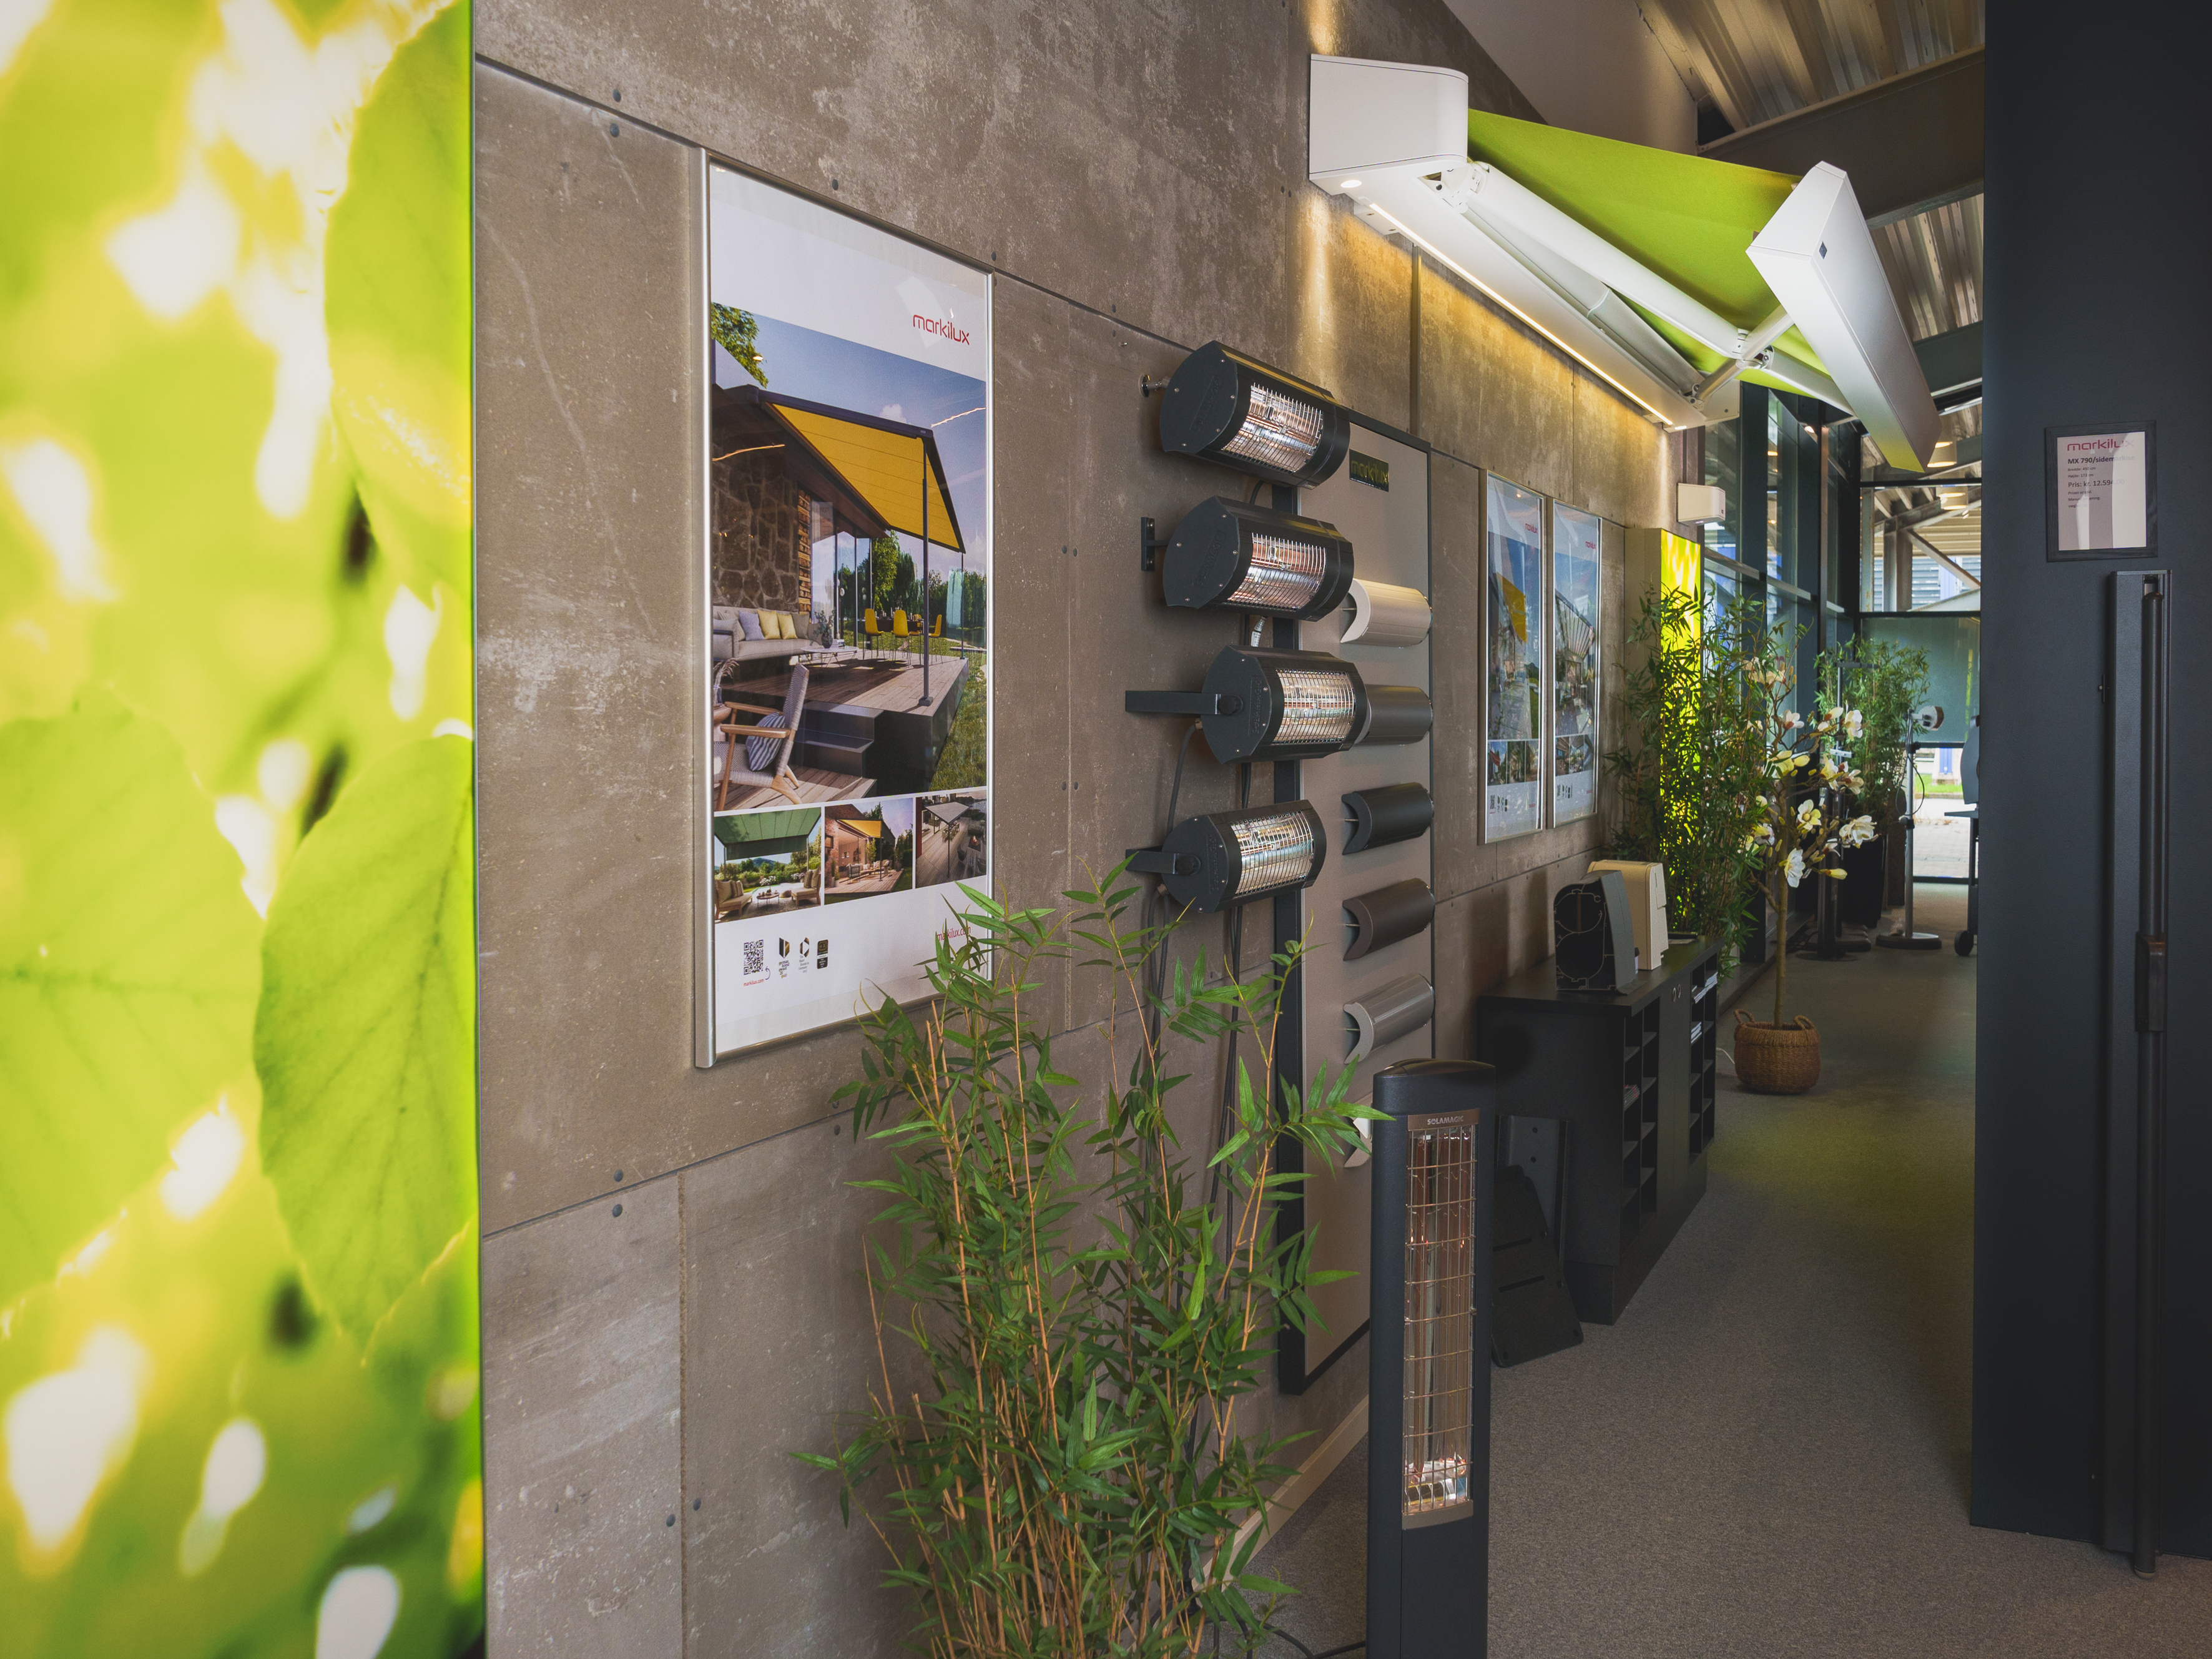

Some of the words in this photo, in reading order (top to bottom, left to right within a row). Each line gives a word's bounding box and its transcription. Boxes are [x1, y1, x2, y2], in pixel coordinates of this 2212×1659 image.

[913, 314, 970, 345] markilux
[2067, 438, 2135, 451] markilux
[2080, 455, 2135, 464] 790/sidemarkise
[1350, 460, 1388, 485] markilux
[937, 927, 971, 941] makilux.com
[1427, 1115, 1464, 1125] SOLAMAGIC
